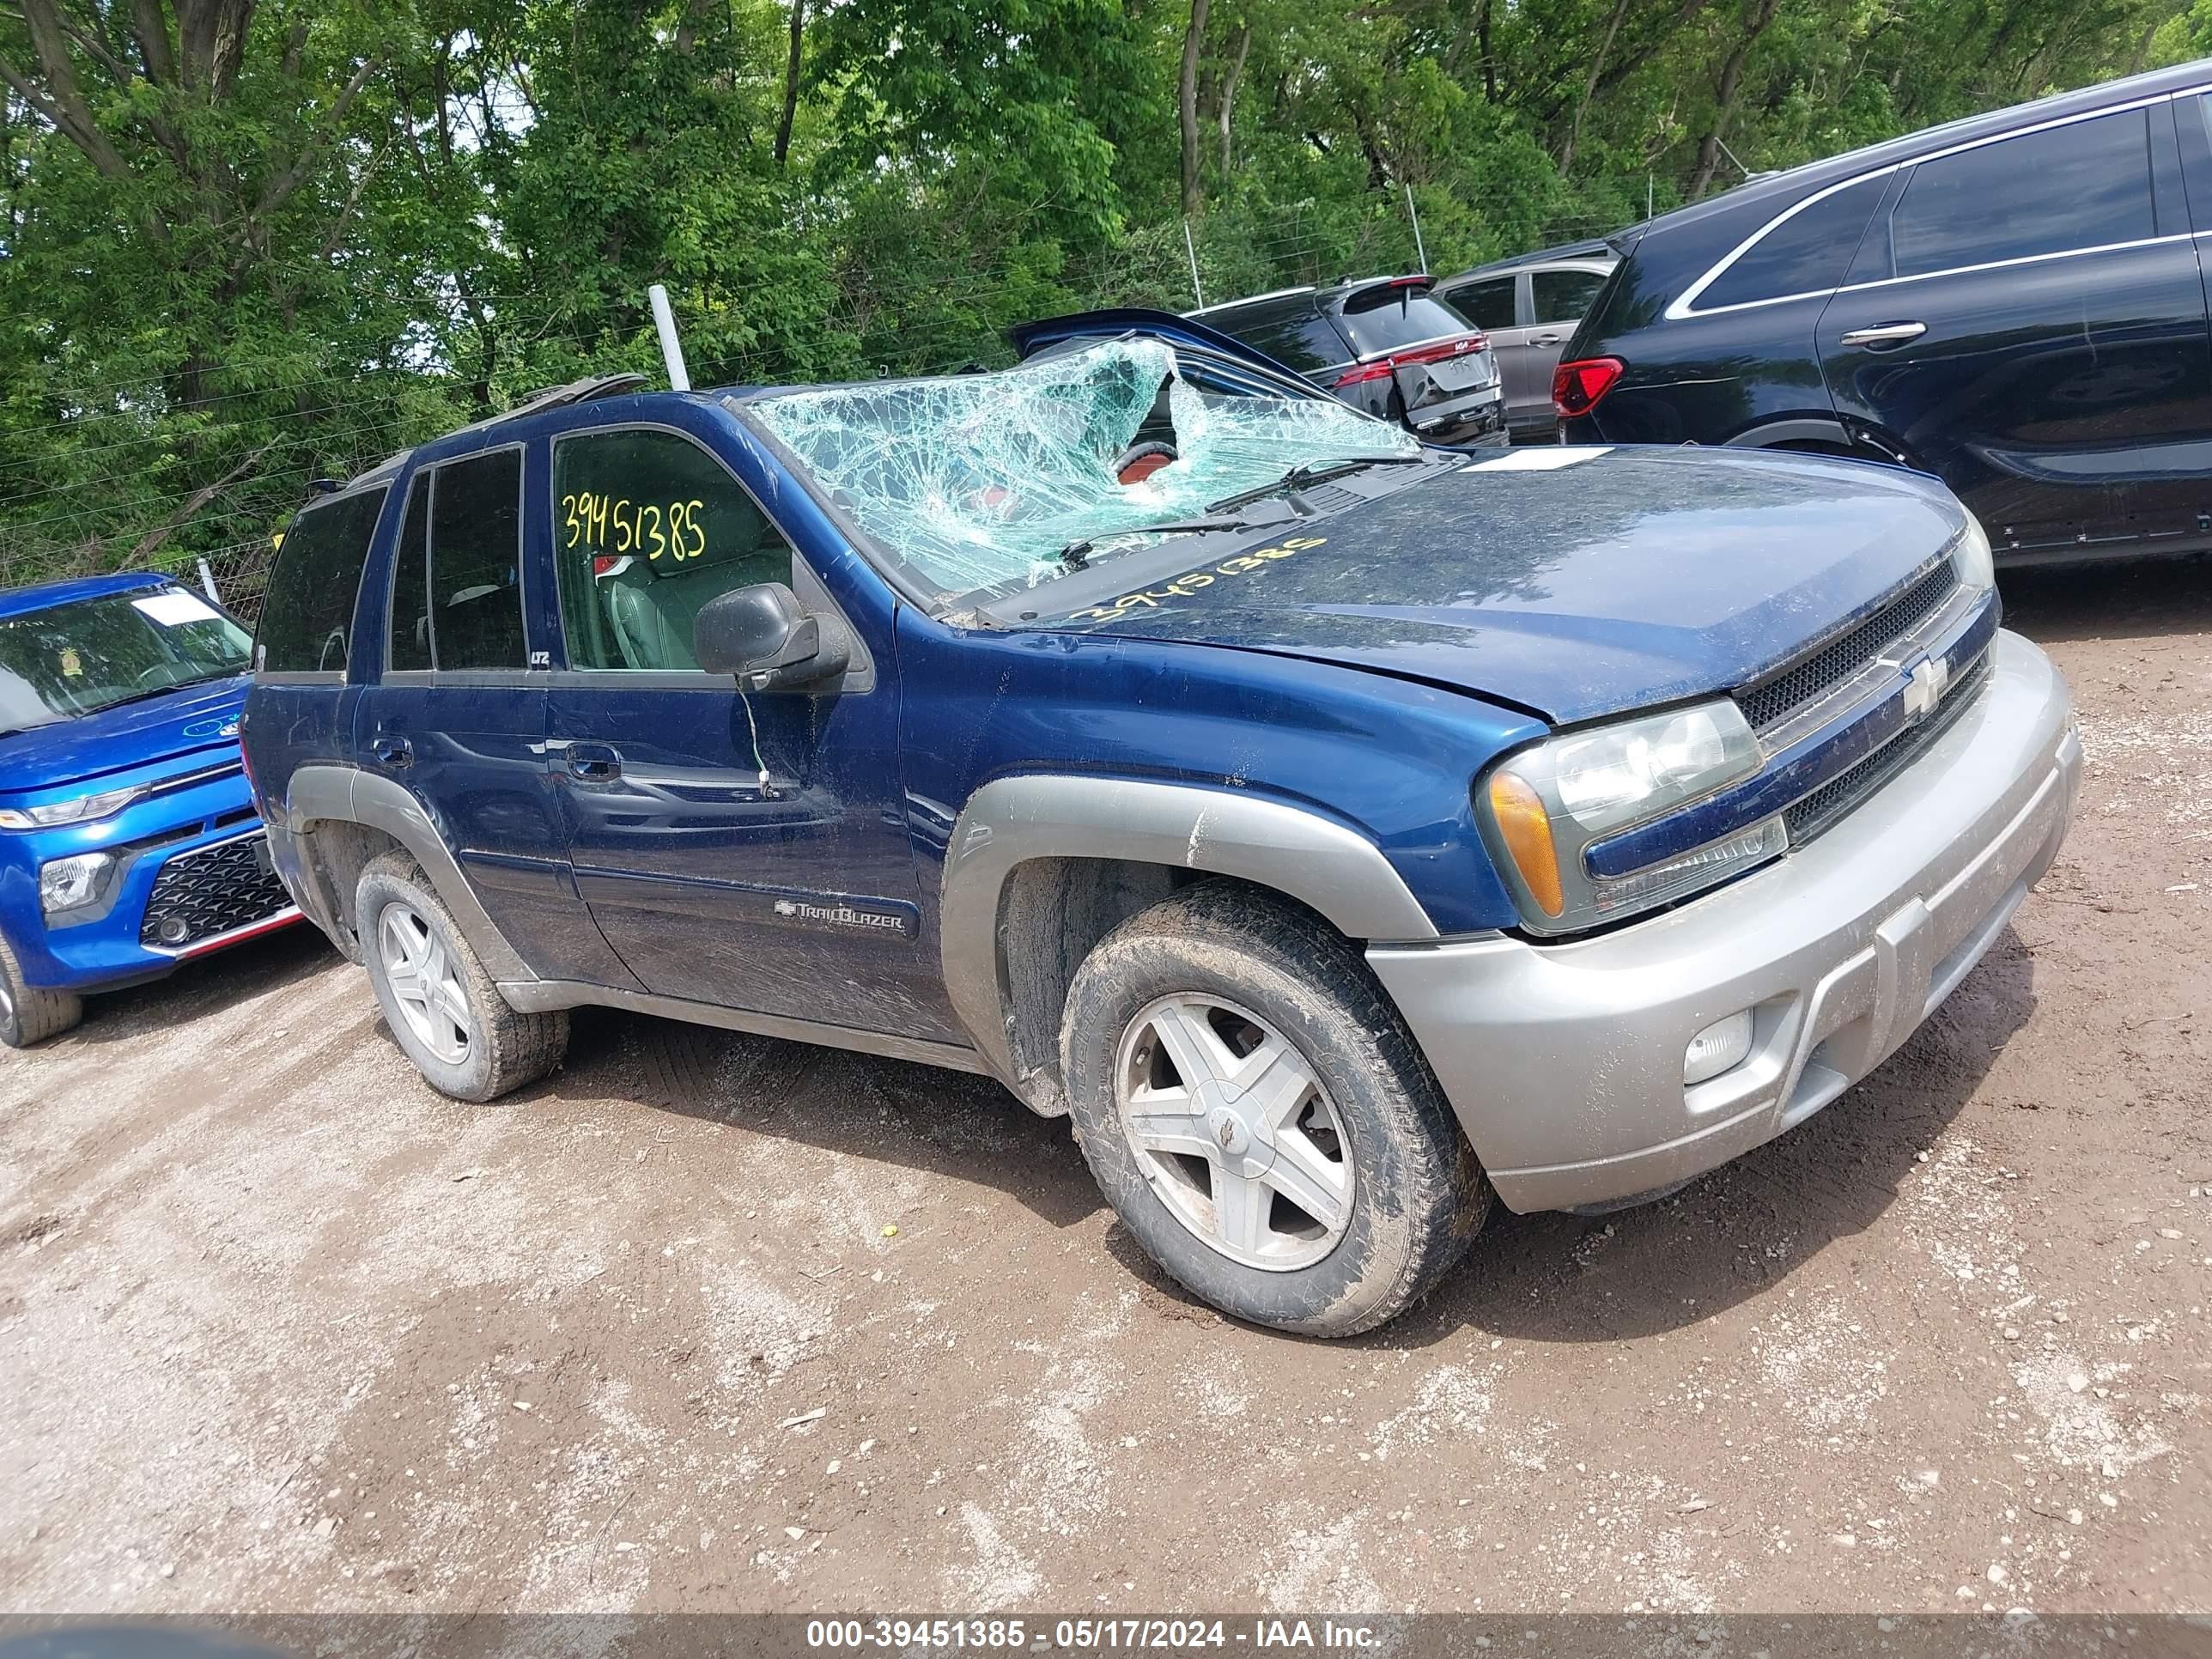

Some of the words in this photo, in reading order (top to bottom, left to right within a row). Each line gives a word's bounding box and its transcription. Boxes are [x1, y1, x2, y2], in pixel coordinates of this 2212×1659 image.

[562, 491, 707, 562] 39451385
[1069, 537, 1328, 623] 39451385
[531, 651, 550, 665] LTZ
